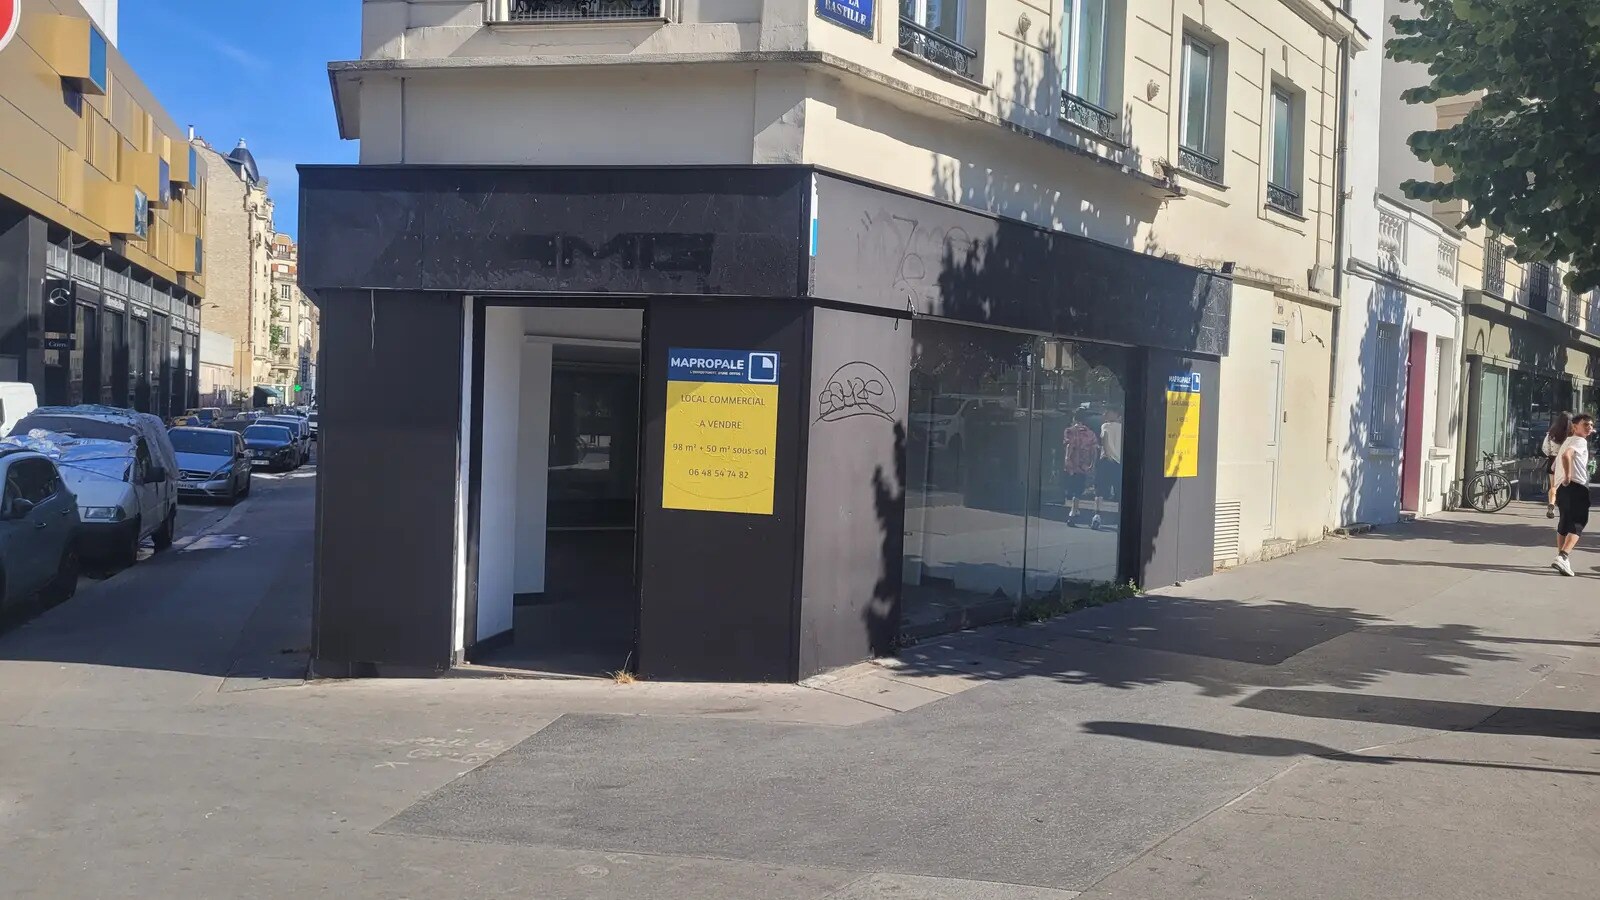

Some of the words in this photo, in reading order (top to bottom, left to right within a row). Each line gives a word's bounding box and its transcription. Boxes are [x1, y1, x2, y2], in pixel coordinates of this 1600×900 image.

[825, 0, 867, 25] BASTILLE
[670, 357, 745, 370] MAPROPALE
[681, 394, 707, 404] LOCAL
[709, 395, 766, 406] COMMERCIAL
[699, 420, 706, 428] A
[707, 420, 742, 430] VENDRE
[672, 443, 683, 451] 98
[706, 445, 717, 453] 50
[732, 446, 767, 456] sous-sol
[688, 468, 699, 476] 06
[701, 469, 712, 477] 48
[714, 469, 725, 477] 54
[727, 470, 737, 478] 74
[738, 471, 749, 479] 82
